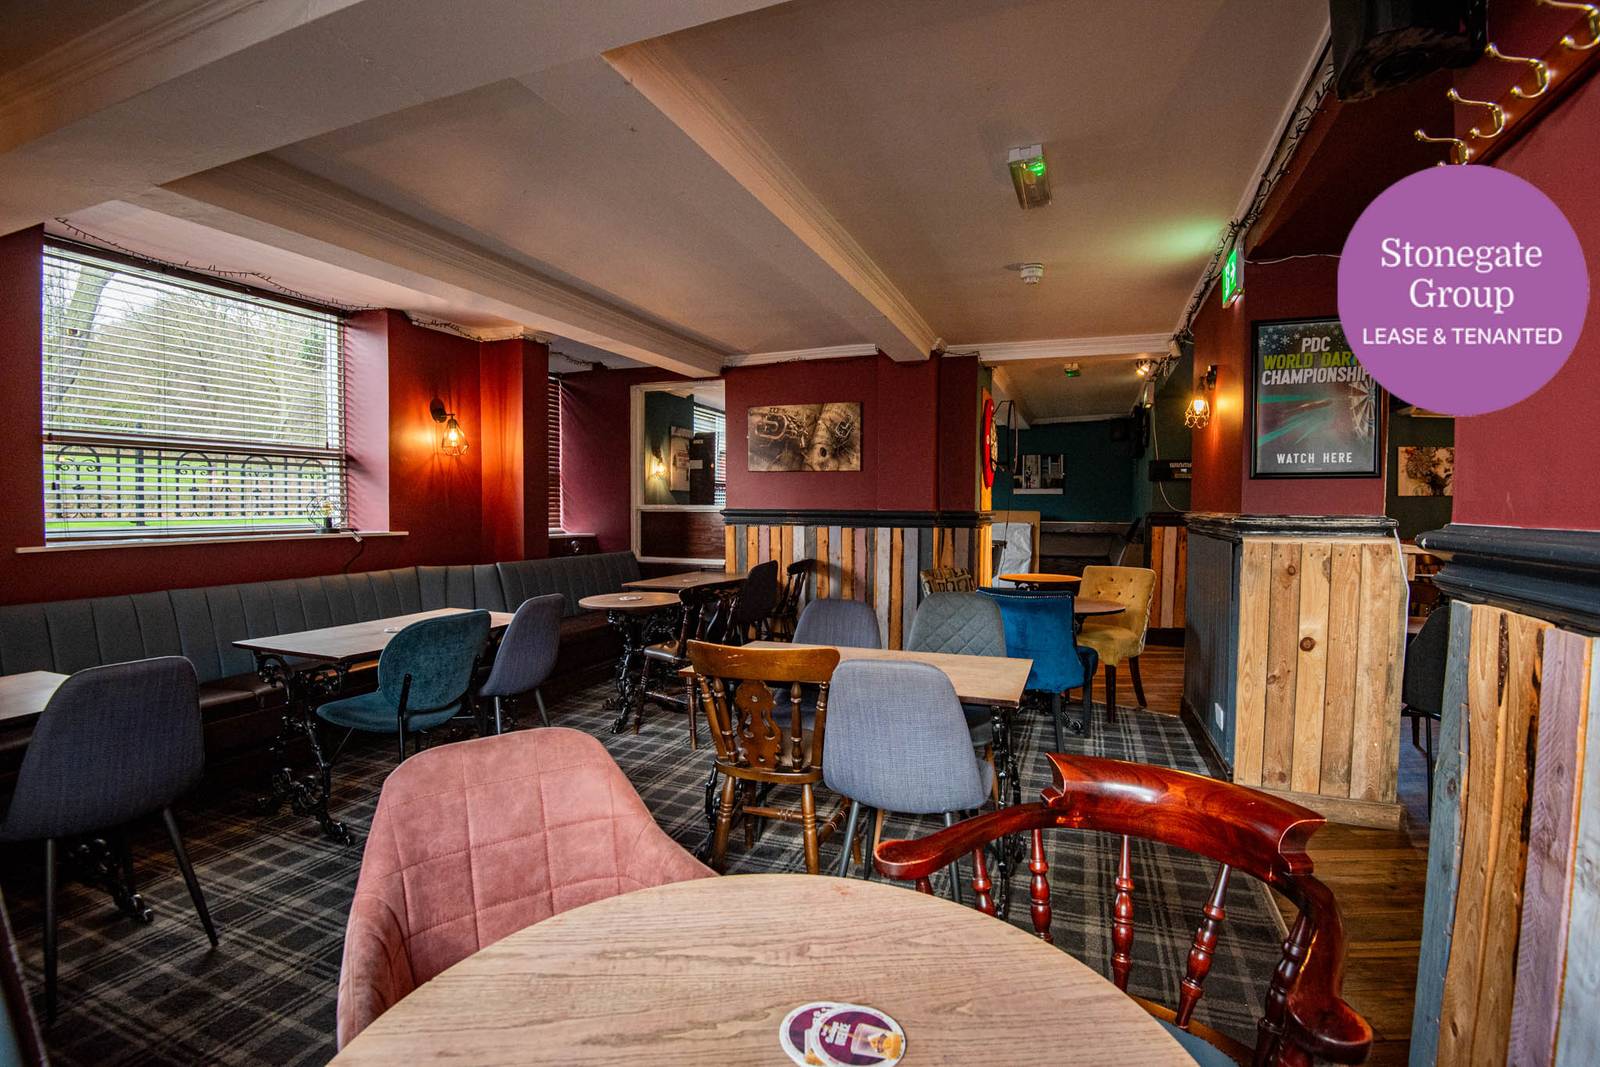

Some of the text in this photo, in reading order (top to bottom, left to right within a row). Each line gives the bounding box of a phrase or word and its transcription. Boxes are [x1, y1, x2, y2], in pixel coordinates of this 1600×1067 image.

[1301, 336, 1331, 353] PDC
[1263, 353, 1313, 370] WORLD
[1276, 452, 1353, 464] WATCH HERE
